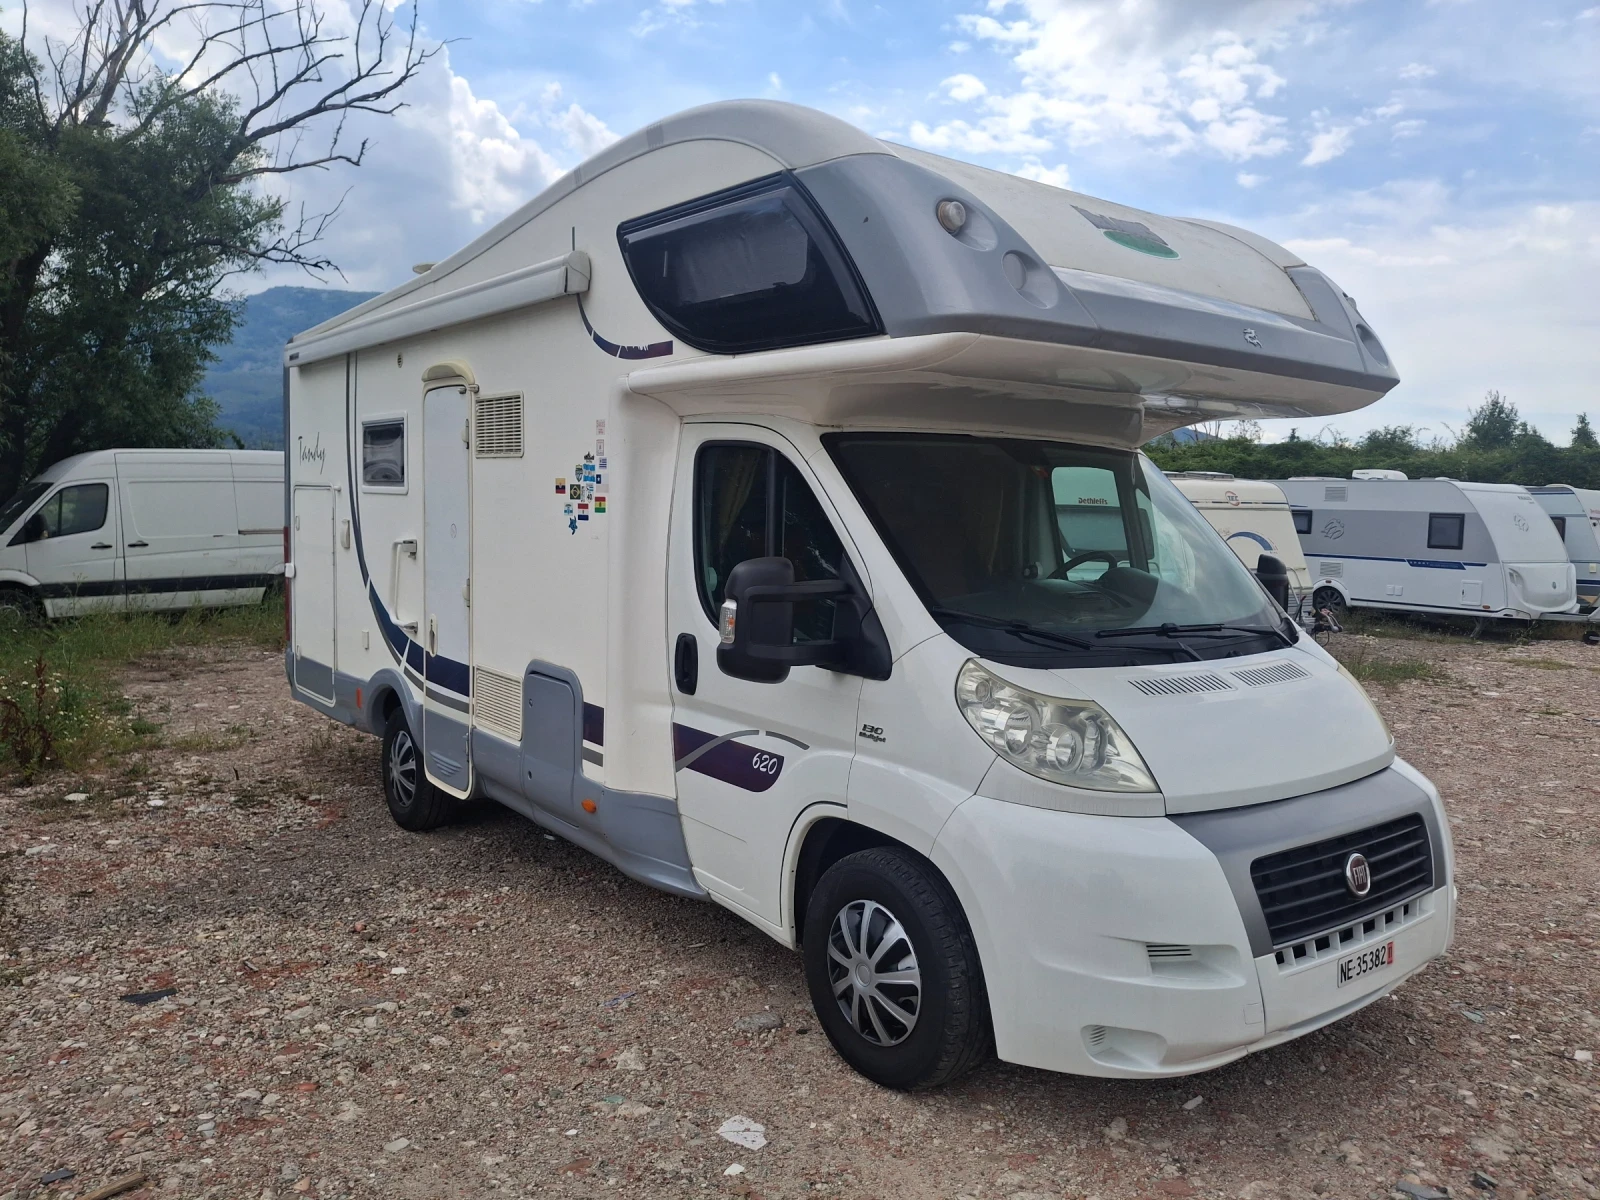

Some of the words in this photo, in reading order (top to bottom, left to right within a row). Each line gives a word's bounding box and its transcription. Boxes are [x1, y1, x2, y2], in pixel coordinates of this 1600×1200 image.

[1078, 497, 1108, 505] Dethleffs
[861, 723, 884, 736] 130
[752, 752, 778, 775] 620
[1352, 864, 1367, 886] FIAT
